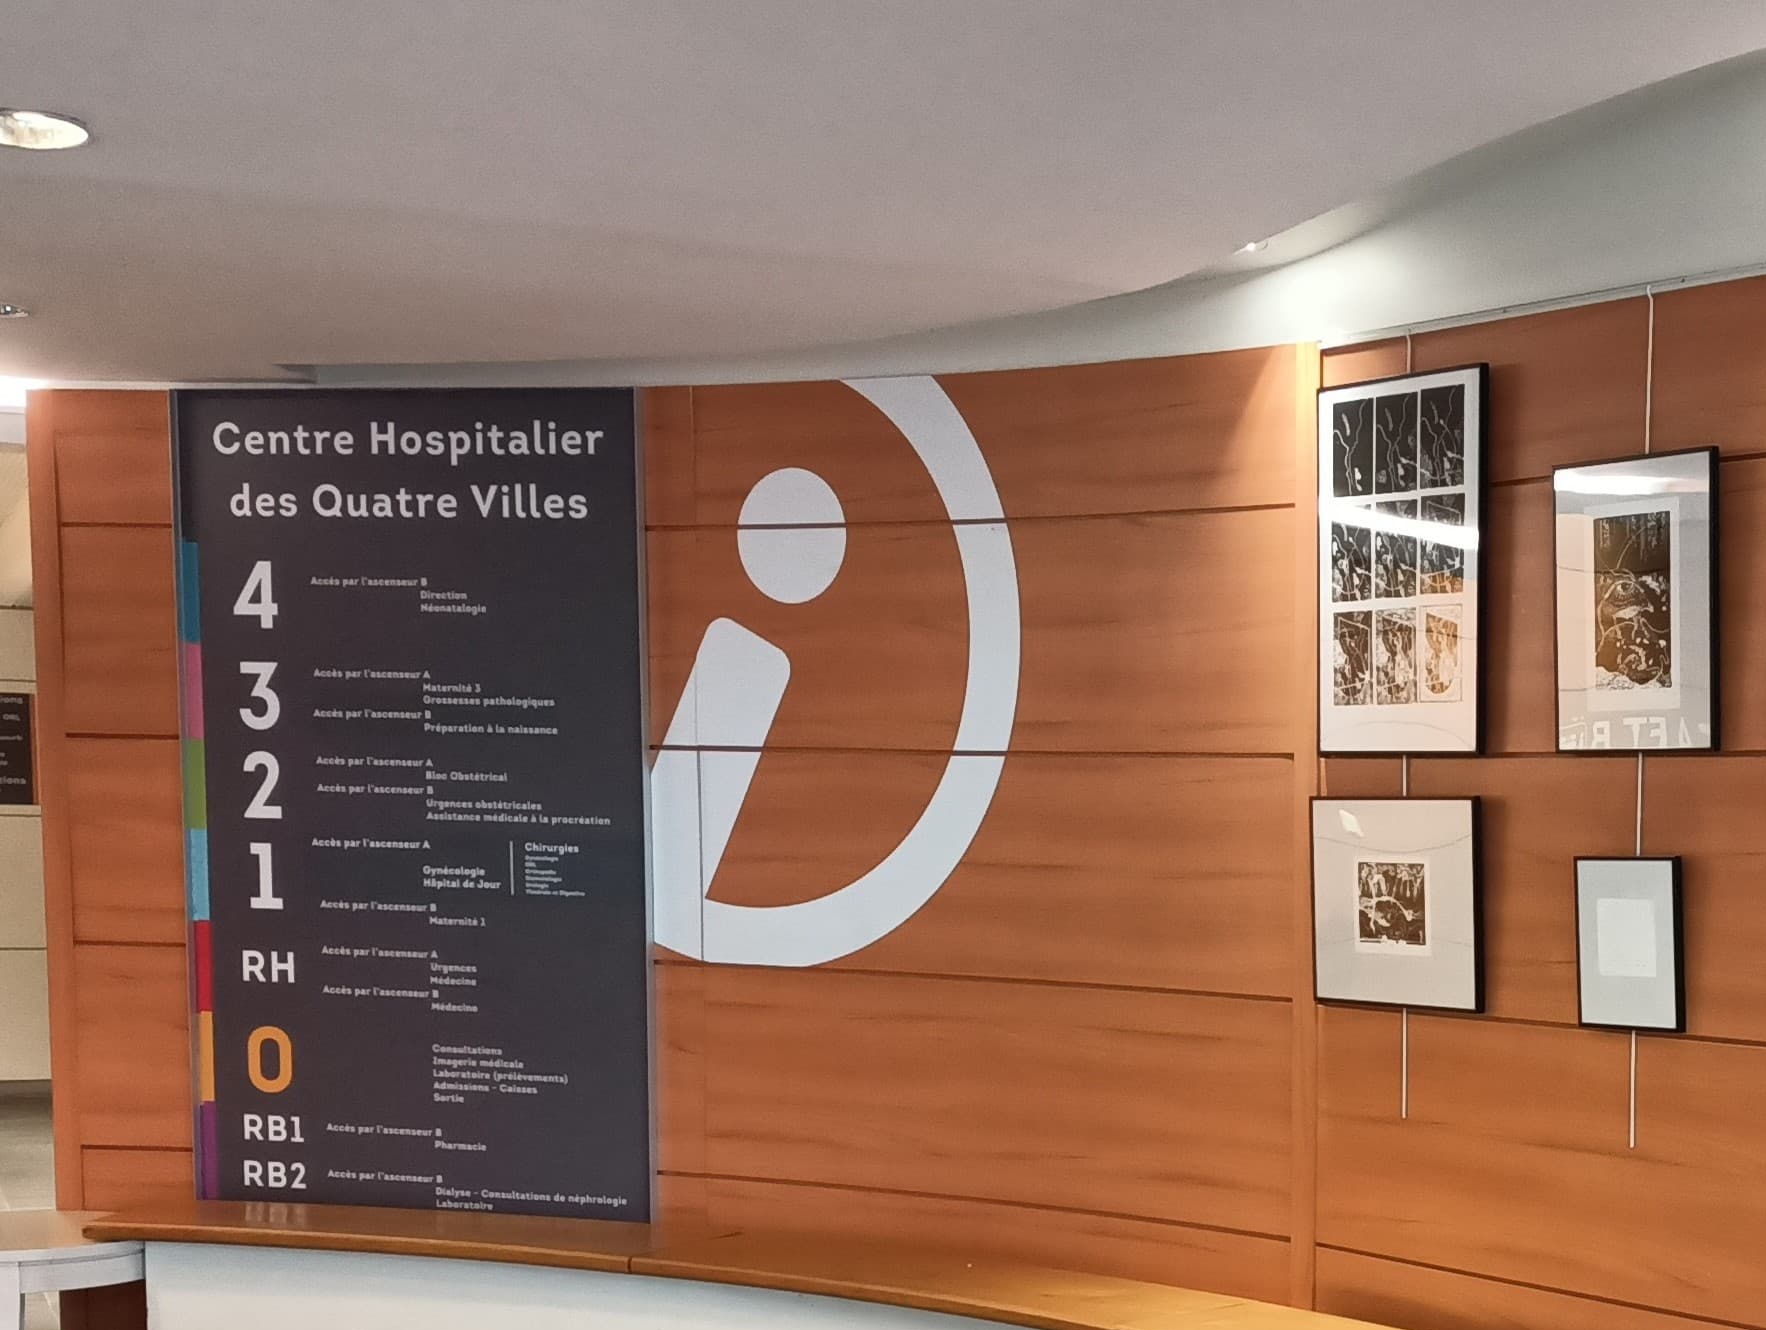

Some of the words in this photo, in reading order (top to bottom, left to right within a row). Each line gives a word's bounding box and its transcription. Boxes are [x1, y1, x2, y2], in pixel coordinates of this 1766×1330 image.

[213, 422, 354, 454] Centre
[371, 420, 604, 466] Hospitalier
[230, 483, 298, 517] des
[312, 484, 458, 518] Quatre
[470, 484, 589, 519] Villes
[310, 576, 339, 585] Accès
[342, 577, 359, 587] par
[361, 576, 418, 586] l'ascenseur
[420, 577, 428, 586] B
[233, 561, 278, 629] 4
[420, 590, 467, 600] Direction
[420, 603, 487, 616] Néonatalogie
[313, 668, 342, 678] Accès
[345, 671, 361, 680] par
[364, 668, 421, 679] l'ascenseur
[423, 671, 430, 679] A
[423, 683, 472, 693] Maternité
[474, 683, 481, 693] 3
[239, 661, 280, 730] 3
[423, 695, 480, 706] Grossesses
[483, 697, 556, 709] pathologiques
[313, 708, 343, 718] Accès
[346, 711, 362, 720] par
[364, 708, 422, 719] l'ascenseur
[425, 710, 431, 719] B
[424, 722, 484, 735] Préparation
[487, 723, 493, 734] à
[496, 724, 505, 734] la
[508, 725, 558, 736] naissance
[316, 756, 346, 766] Accès
[348, 758, 364, 768] par
[366, 756, 423, 767] l'ascenseur
[425, 759, 433, 767] A
[426, 770, 447, 780] Bloc
[450, 771, 508, 782] Obstétrical
[243, 750, 282, 819] 2
[317, 783, 346, 793] Accès
[348, 785, 365, 795] par
[368, 783, 424, 795] l'ascenseur
[427, 786, 434, 795] B
[426, 798, 473, 811] Urgences
[475, 799, 542, 811] obstétricales
[426, 812, 480, 822] Assistance
[484, 813, 528, 823] médicale
[530, 814, 536, 824] à
[539, 815, 548, 824] la
[551, 815, 611, 827] procréation
[312, 838, 341, 848] Accès
[344, 840, 361, 850] par
[363, 838, 420, 849] l'ascenseur
[423, 841, 430, 849] A
[525, 842, 579, 855] Chirurgies
[250, 842, 284, 909] 1
[423, 865, 485, 878] Gynécologie
[423, 877, 460, 890] Hôpital
[462, 879, 475, 889] de
[479, 879, 502, 890] Jour
[320, 899, 350, 910] Accès
[352, 902, 369, 911] par
[371, 900, 427, 912] l'ascenseur
[430, 903, 436, 912] B
[429, 916, 478, 926] Maternité
[321, 945, 351, 955] Accès
[353, 948, 370, 958] par
[372, 947, 428, 959] l'ascenseur
[430, 950, 438, 959] A
[242, 950, 295, 983] RH
[430, 962, 477, 974] Urgences
[430, 976, 477, 986] Médecine
[322, 985, 352, 995] Accès
[354, 988, 371, 997] par
[373, 986, 430, 998] l'ascenseur
[432, 989, 439, 998] B
[431, 1002, 478, 1013] Médecine
[432, 1044, 503, 1056] Consultations
[248, 1026, 292, 1093] 0
[433, 1056, 477, 1068] Imagerie
[479, 1058, 524, 1069] médicale
[433, 1069, 490, 1080] Laboratoire
[433, 1081, 490, 1092] Admissions
[499, 1083, 538, 1094] Caisses
[433, 1092, 464, 1103] Sortie
[243, 1113, 304, 1143] RB1
[326, 1123, 356, 1133] Accès
[358, 1125, 374, 1135] par
[376, 1124, 432, 1137] l'ascenseur
[435, 1128, 442, 1137] B
[434, 1140, 487, 1152] Pharmacie
[243, 1160, 307, 1190] RB2
[327, 1169, 357, 1179] Accès
[359, 1171, 376, 1181] par
[378, 1170, 433, 1183] l'ascenseur
[436, 1174, 443, 1183] B
[435, 1186, 471, 1199] Dialyse
[481, 1188, 551, 1202] Consultations
[553, 1193, 566, 1203] de
[568, 1193, 627, 1208] néphrologie
[436, 1198, 493, 1211] Laboratoire
